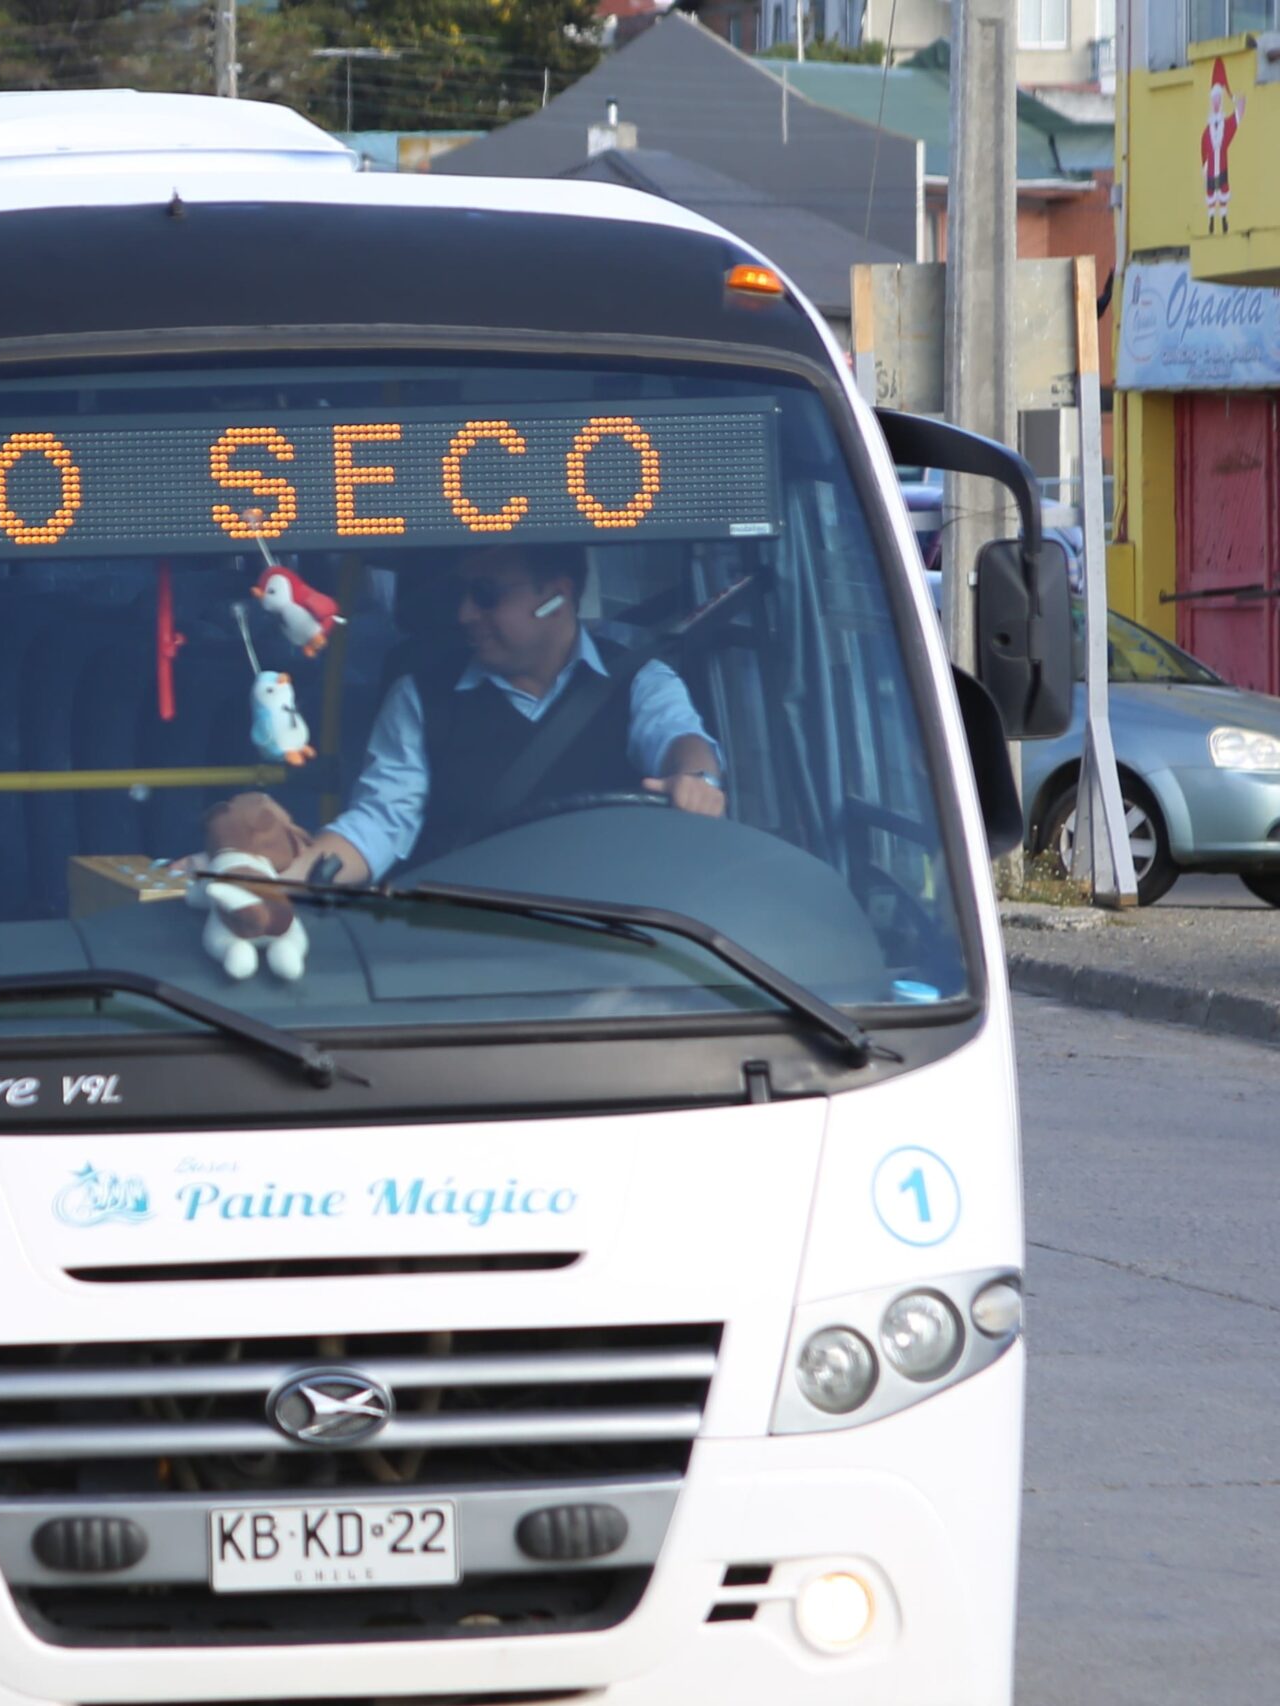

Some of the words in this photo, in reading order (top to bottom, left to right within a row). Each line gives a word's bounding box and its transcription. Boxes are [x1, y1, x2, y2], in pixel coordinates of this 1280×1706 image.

[209, 416, 660, 539] SECO
[63, 1074, 122, 1105] V9L
[175, 1181, 347, 1222] Paine
[367, 1176, 579, 1227] Mágico
[898, 1166, 932, 1223] 1
